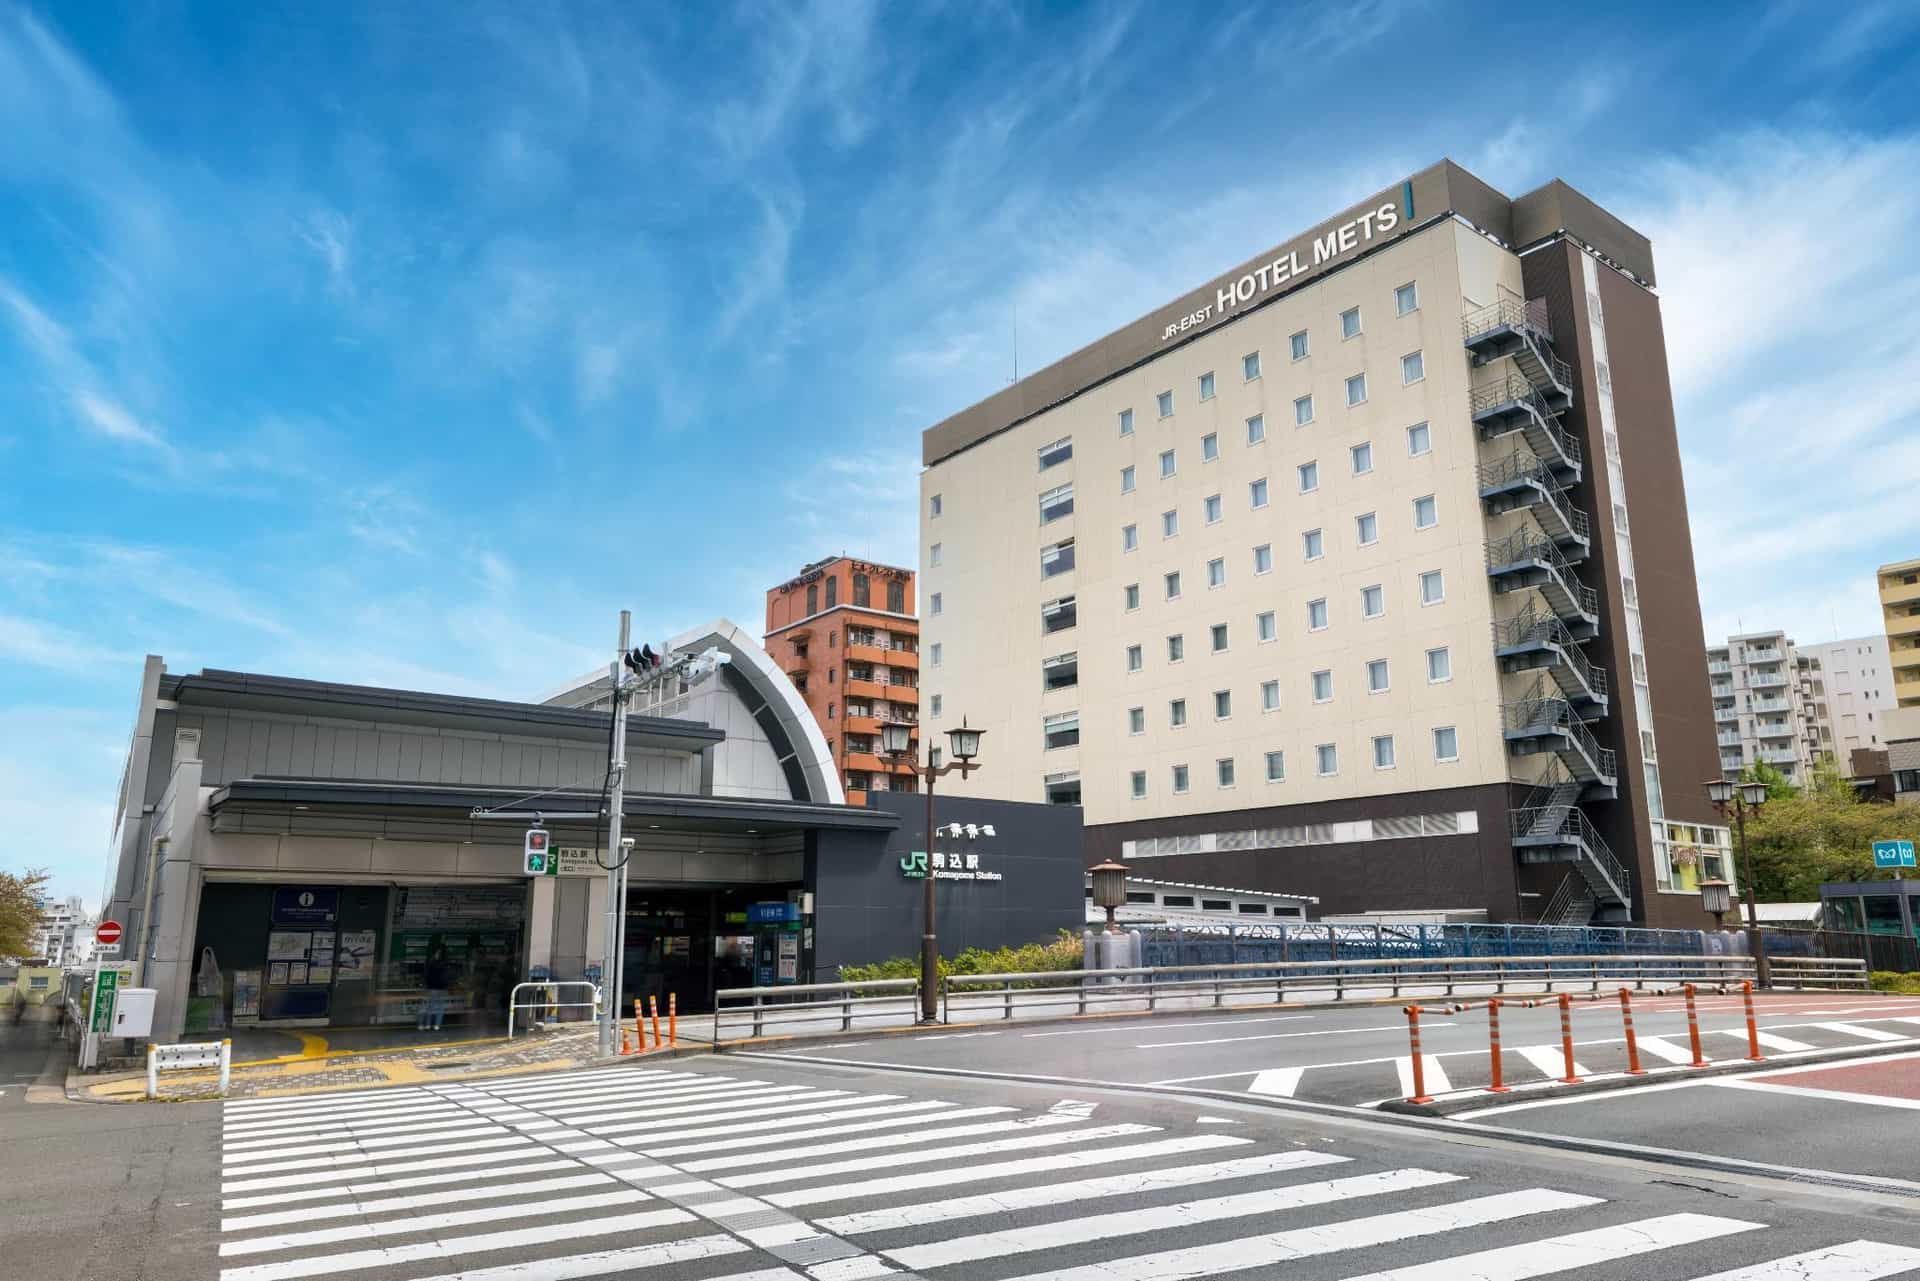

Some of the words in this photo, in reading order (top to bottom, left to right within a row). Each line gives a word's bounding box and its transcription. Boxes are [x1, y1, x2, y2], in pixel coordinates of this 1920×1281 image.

[1161, 304, 1213, 341] JR-EAST
[1217, 251, 1309, 313] HOTEL
[1313, 202, 1399, 265] METS
[900, 851, 928, 871] JR
[932, 852, 979, 869] 駒込駅
[932, 870, 976, 881] Komagome
[975, 871, 1002, 881] Station
